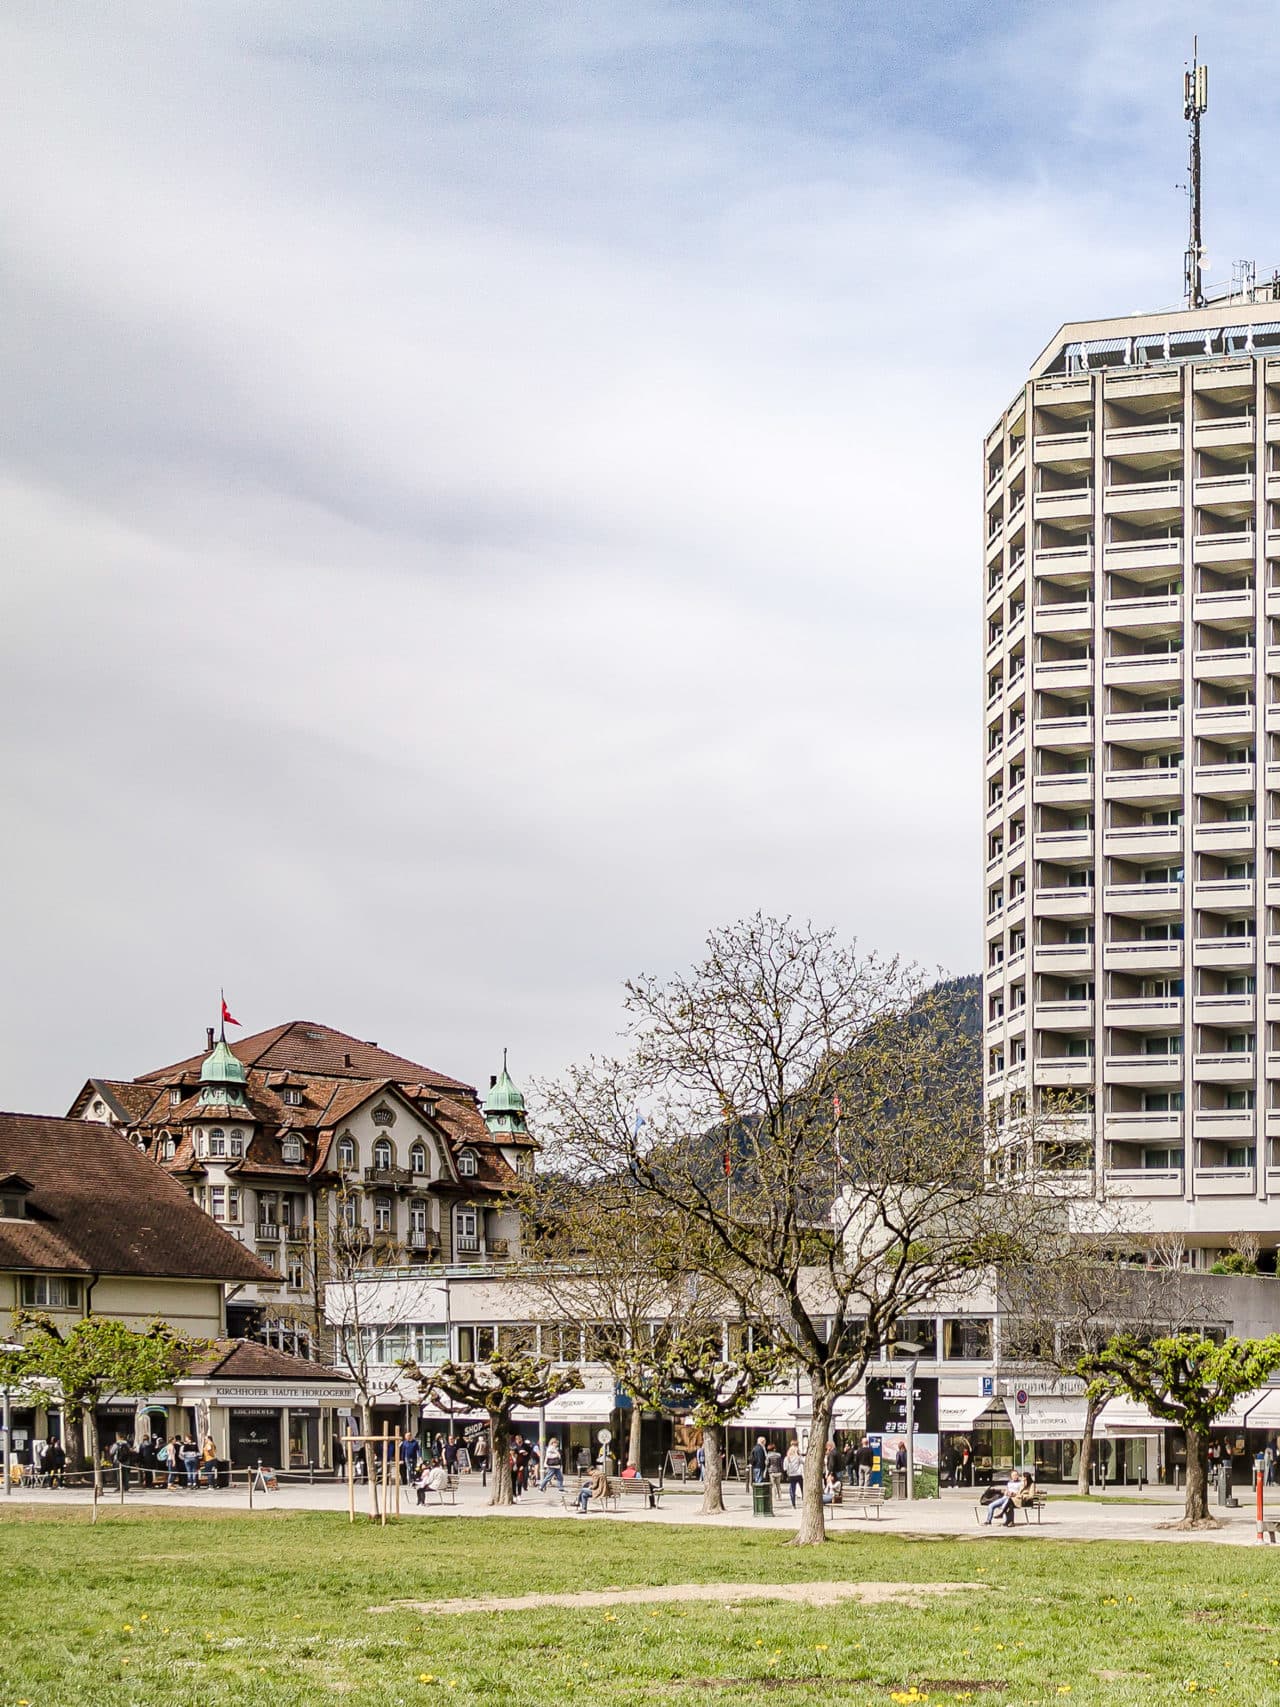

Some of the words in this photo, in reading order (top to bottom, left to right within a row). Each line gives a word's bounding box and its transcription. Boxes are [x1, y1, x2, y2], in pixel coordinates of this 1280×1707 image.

[216, 1387, 268, 1396] KIRCHHOFER
[272, 1388, 299, 1397] HAUTE
[302, 1388, 351, 1397] HORLOGERIE
[883, 1388, 922, 1397] TISST
[464, 1422, 484, 1436] SHOP
